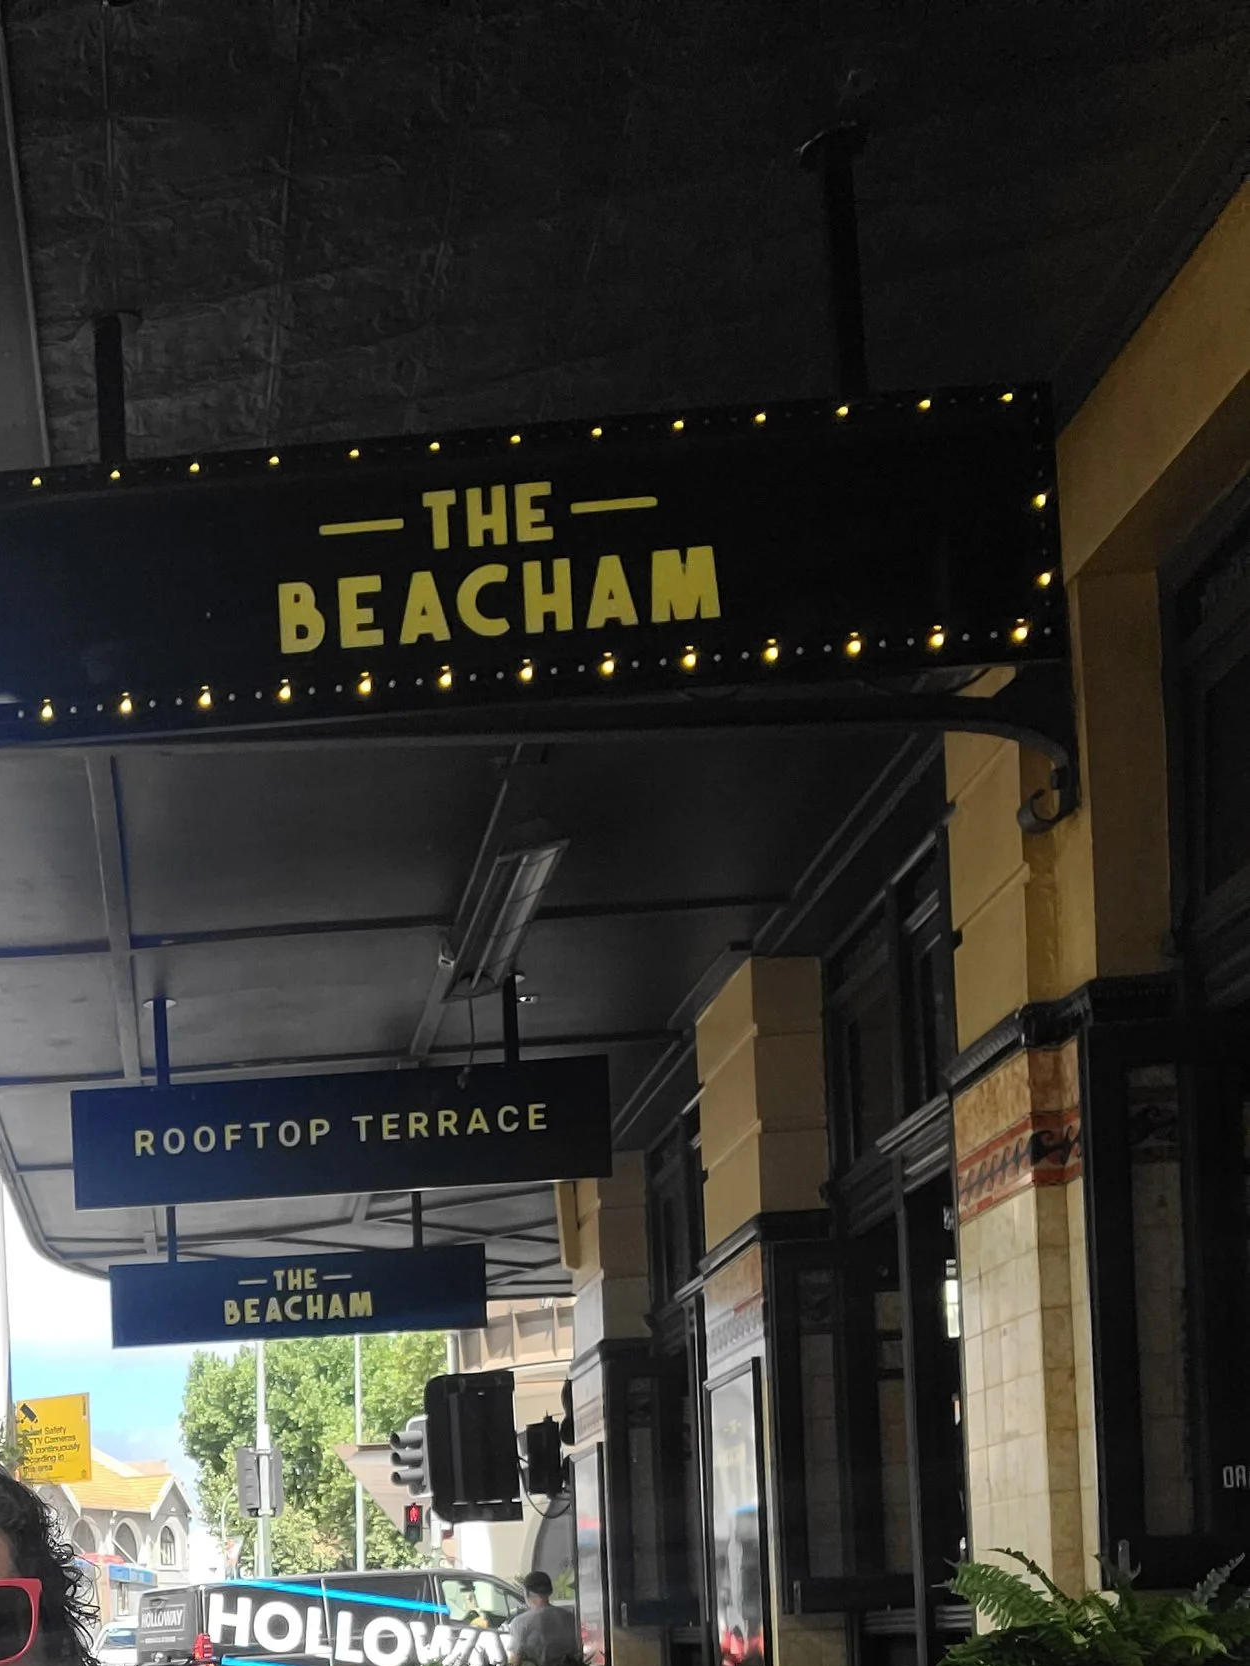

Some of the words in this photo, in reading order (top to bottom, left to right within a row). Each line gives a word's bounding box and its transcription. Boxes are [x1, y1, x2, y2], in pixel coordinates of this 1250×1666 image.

[422, 481, 554, 550] THE
[278, 545, 721, 654] BEACHAM
[134, 1118, 331, 1157] ROOFTOP
[351, 1103, 548, 1142] TERRACE
[273, 1268, 318, 1291] THE
[224, 1291, 373, 1325] BEACHAM
[44, 1426, 67, 1435] Safety
[44, 1435, 77, 1444] Cameras
[141, 1608, 183, 1629] HOLLOWAY
